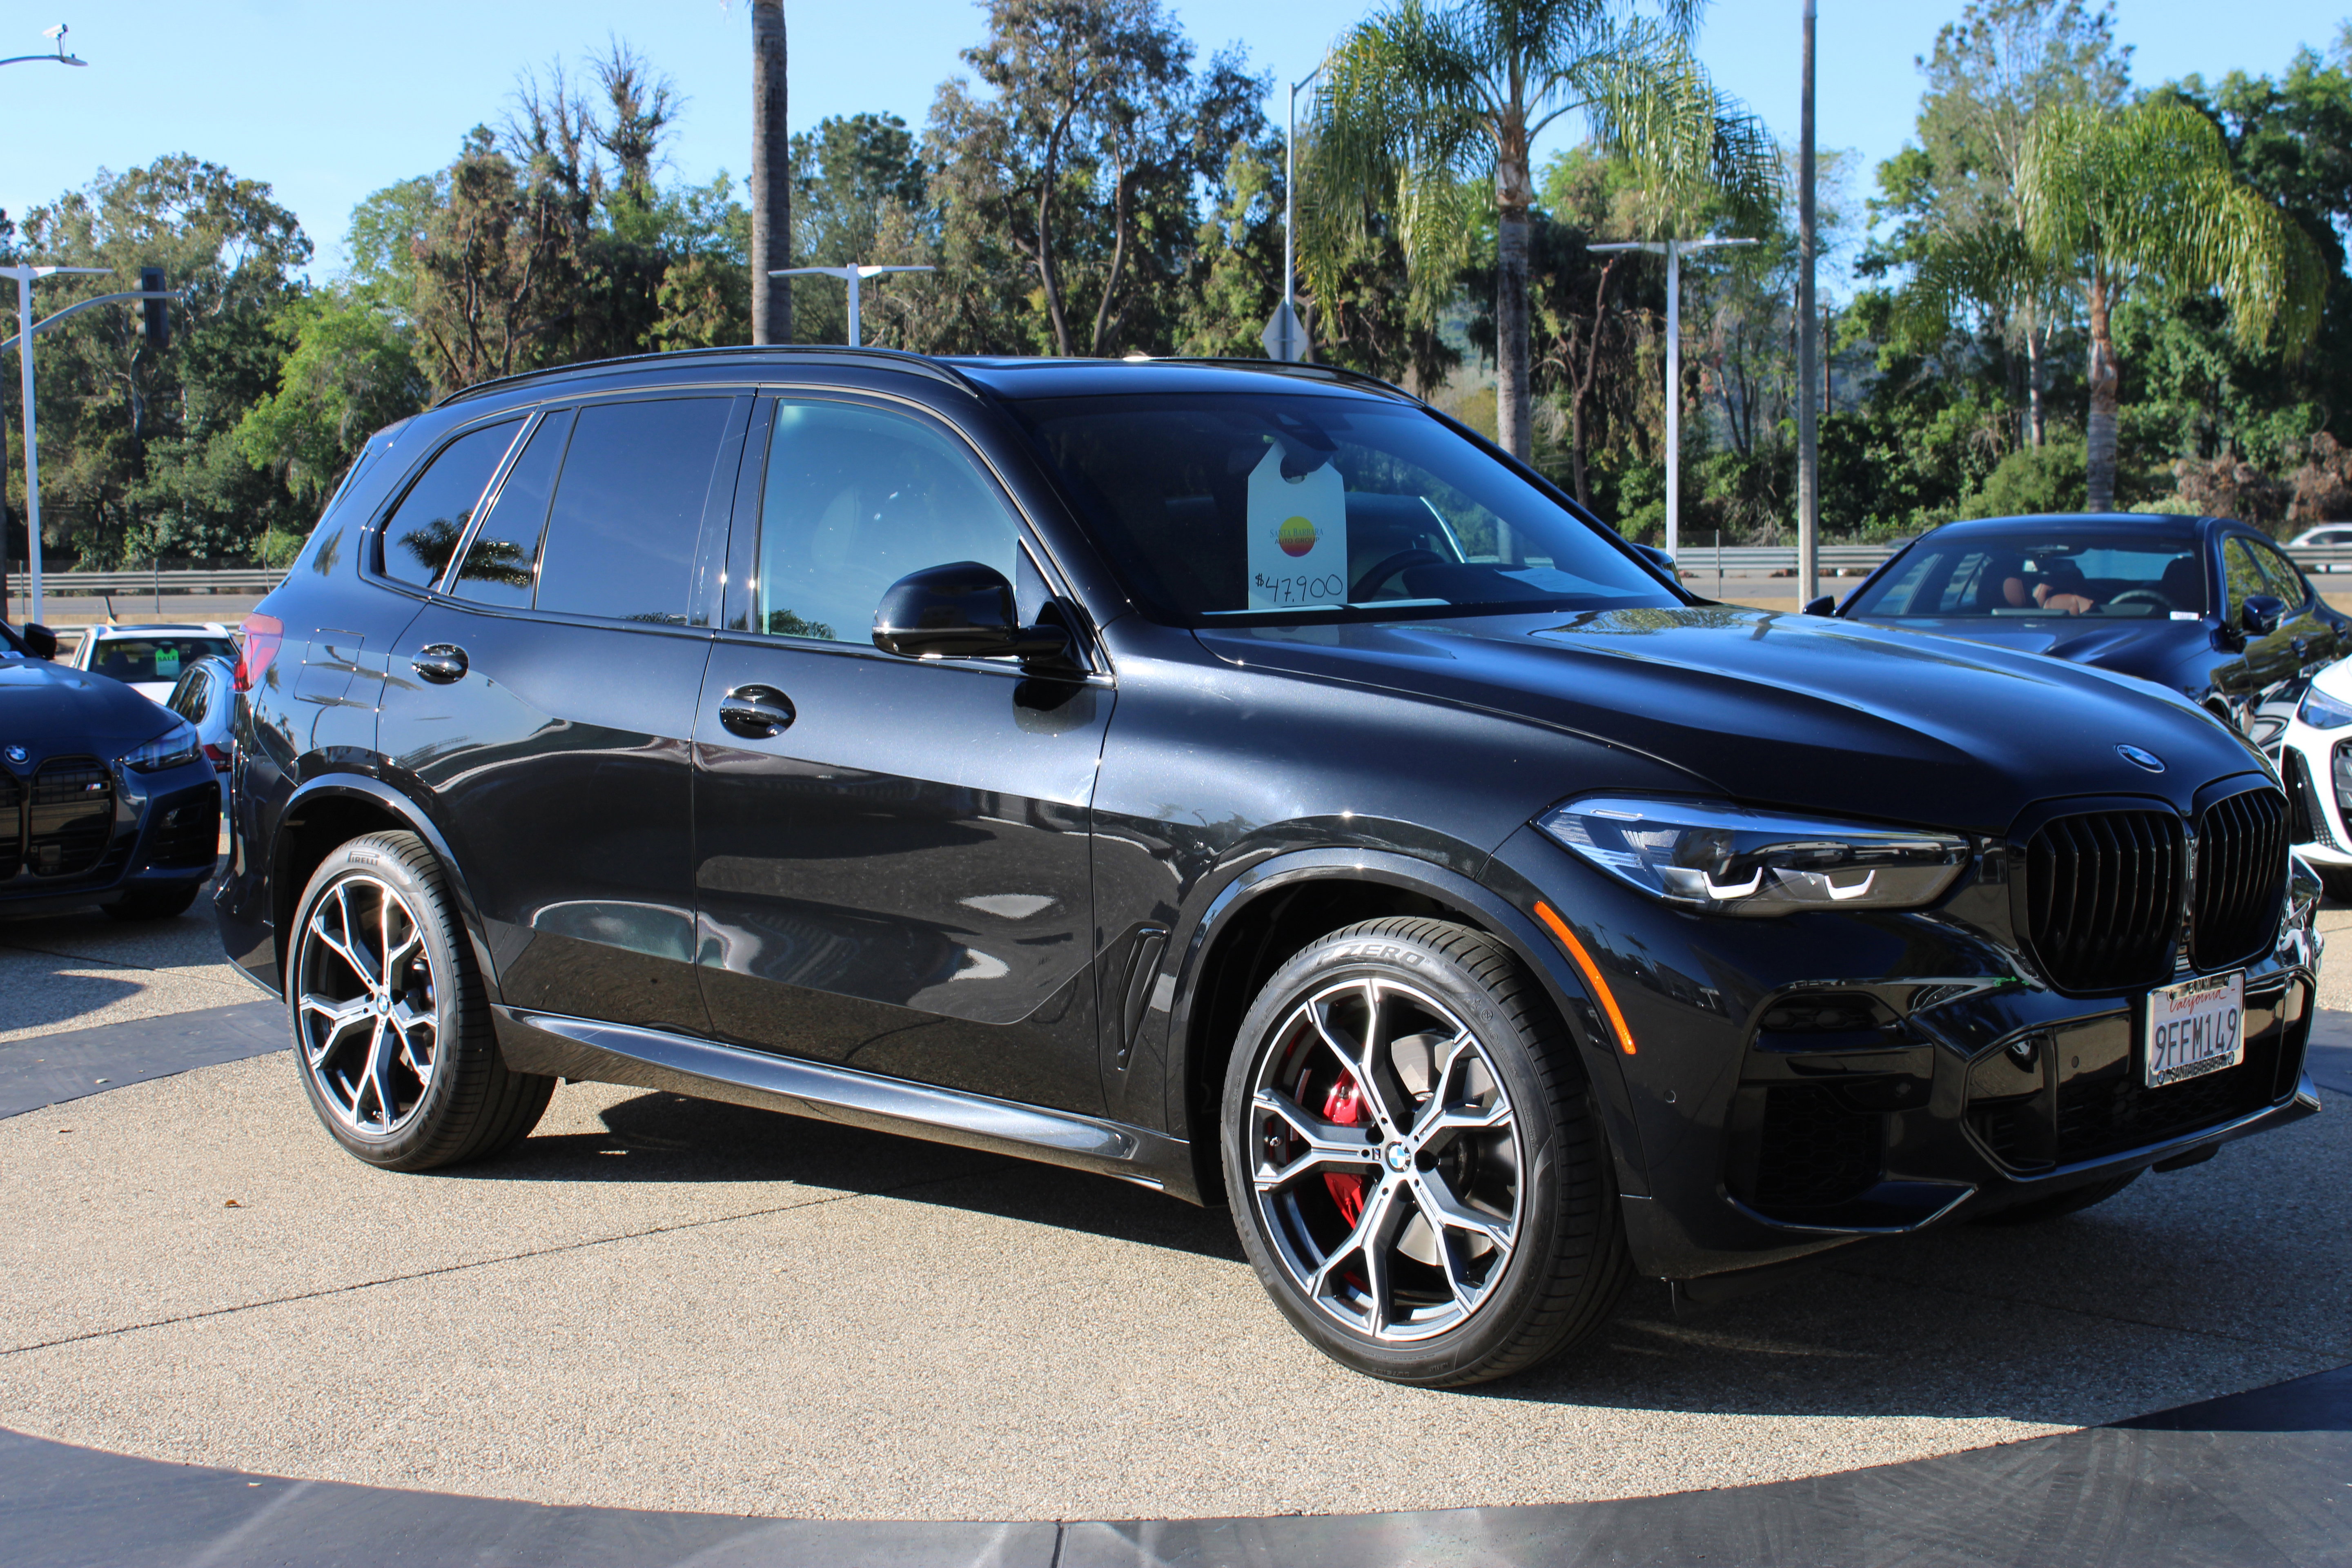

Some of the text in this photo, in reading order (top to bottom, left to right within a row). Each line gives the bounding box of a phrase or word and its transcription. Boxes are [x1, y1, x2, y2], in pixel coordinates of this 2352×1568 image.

[1270, 528, 1323, 538] SANTA BARBARA
[347, 851, 380, 866] PIRELLI
[1340, 944, 1426, 966] ZERO
[2189, 976, 2211, 994] BMW
[2169, 989, 2227, 1015] California
[2154, 1008, 2237, 1069] 9FFM149
[2171, 1054, 2223, 1082] SANTA BARBARA
